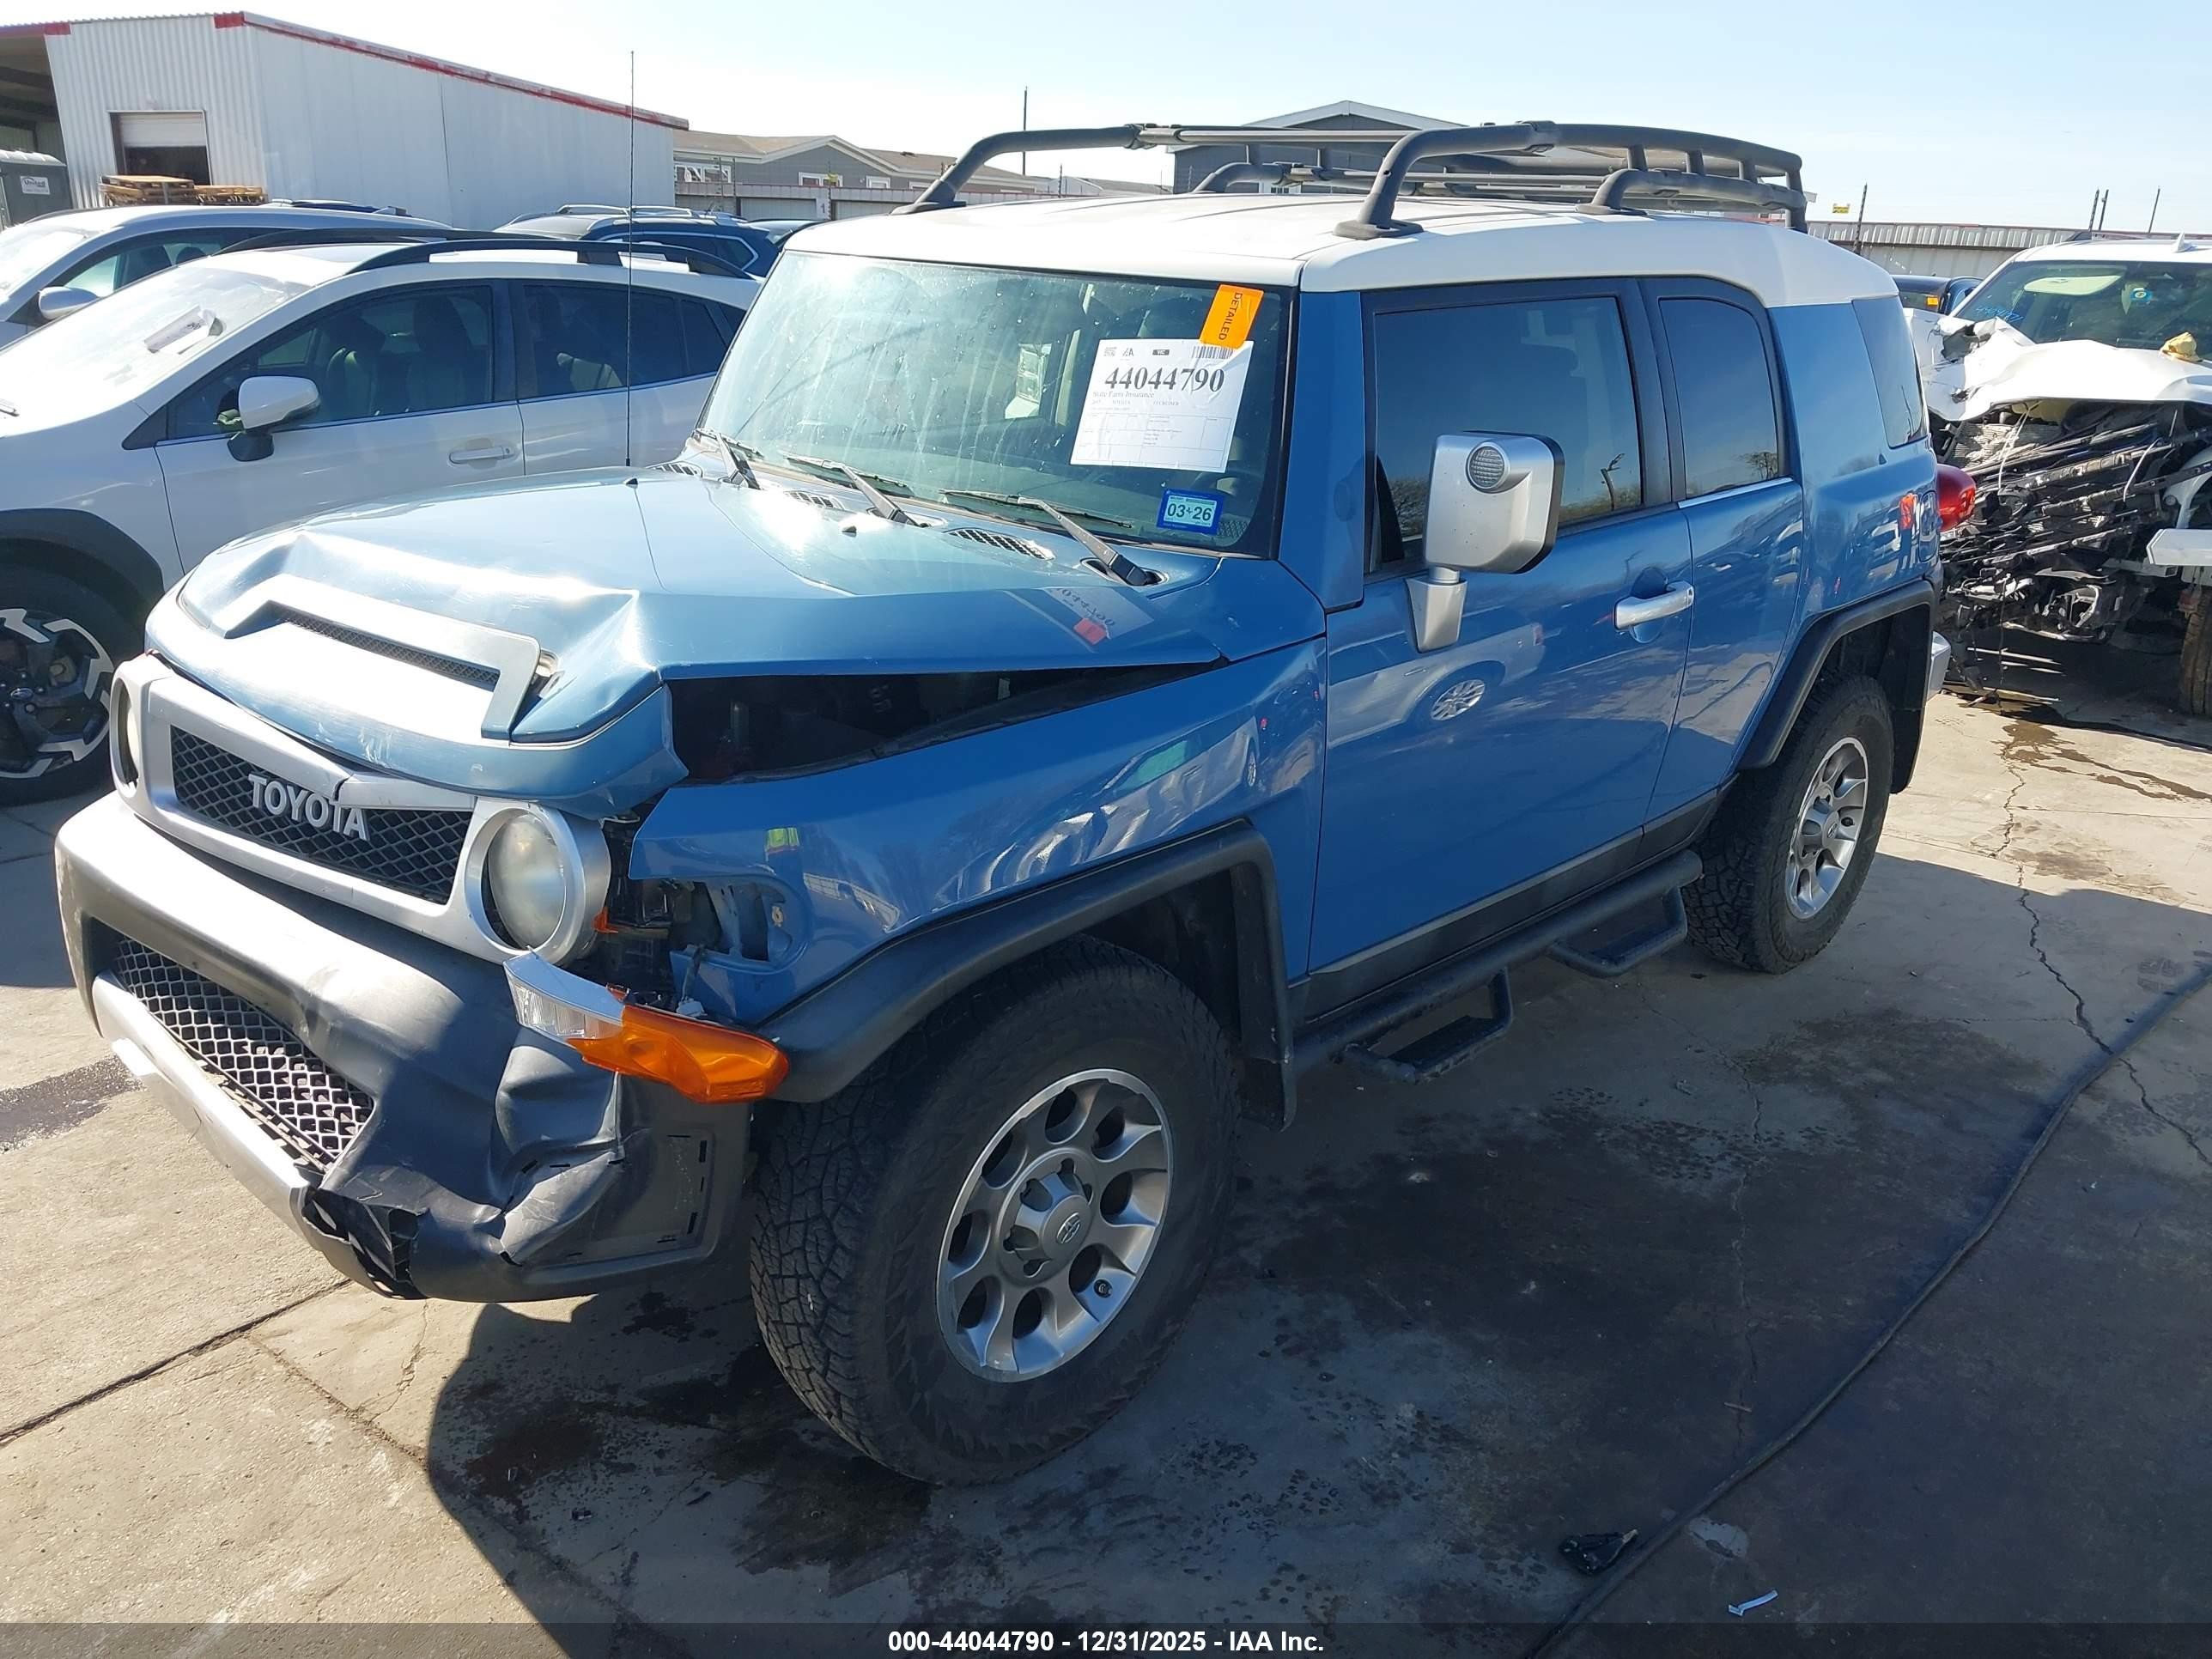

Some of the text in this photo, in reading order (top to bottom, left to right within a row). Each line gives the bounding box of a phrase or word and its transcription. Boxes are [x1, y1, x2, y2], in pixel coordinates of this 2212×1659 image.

[1218, 292, 1243, 341] DETAILED
[1104, 367, 1224, 392] 44044790
[1168, 503, 1212, 521] 03 26
[248, 774, 368, 841] TOYOTA
